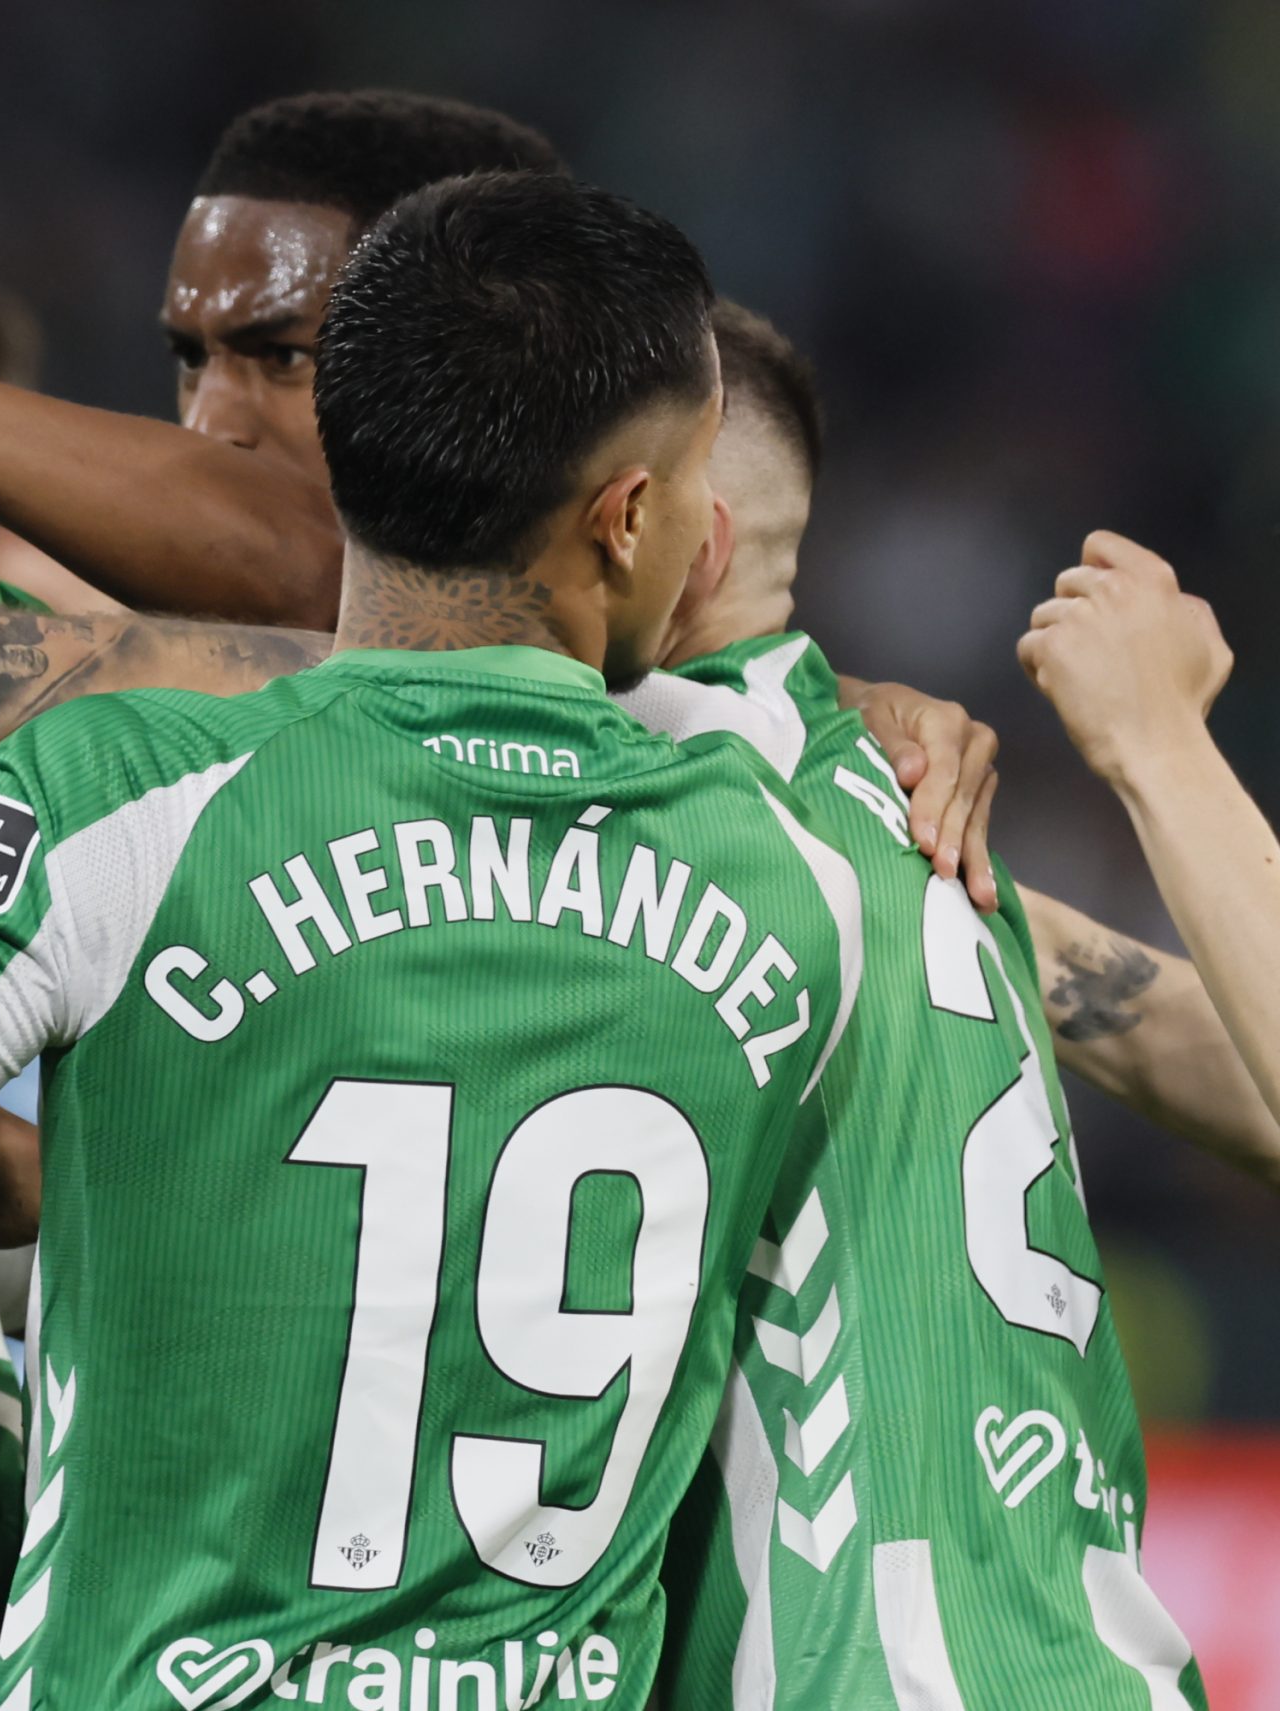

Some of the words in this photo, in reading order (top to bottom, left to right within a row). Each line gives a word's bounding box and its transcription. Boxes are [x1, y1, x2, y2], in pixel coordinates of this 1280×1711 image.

[143, 944, 279, 1043] C.
[247, 804, 812, 1090] HERNÁNDEZ
[282, 1076, 711, 1591] 19
